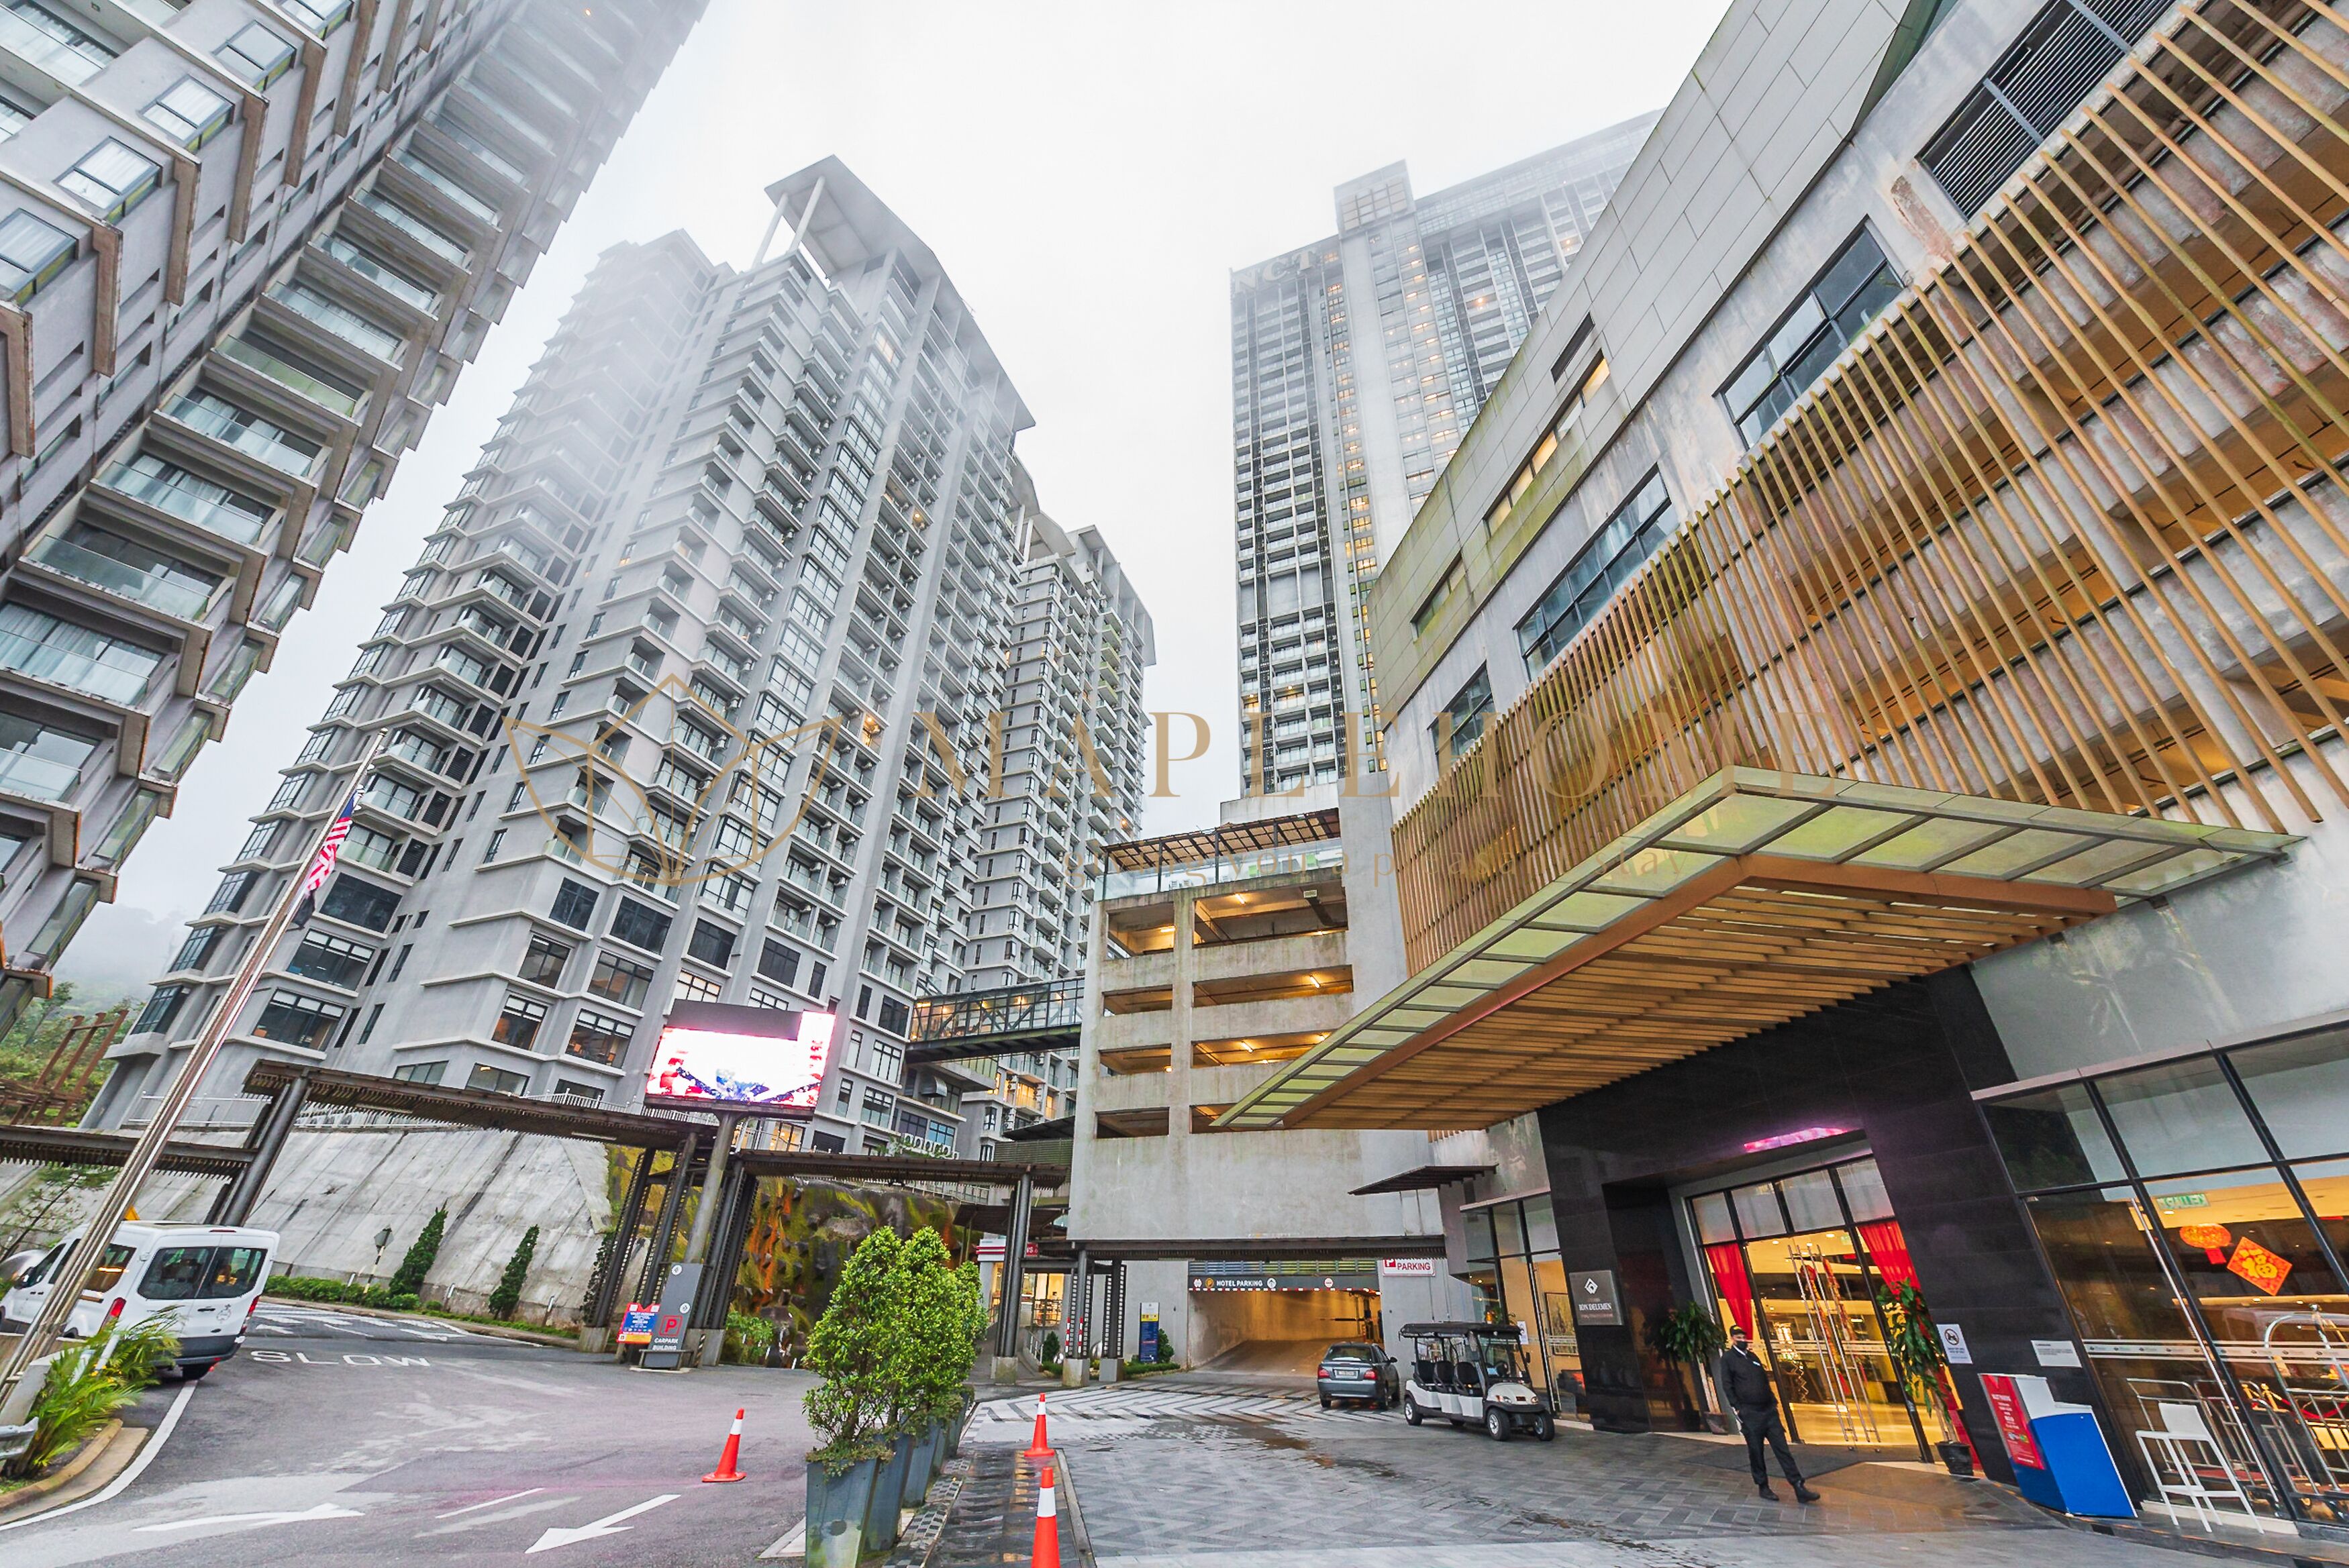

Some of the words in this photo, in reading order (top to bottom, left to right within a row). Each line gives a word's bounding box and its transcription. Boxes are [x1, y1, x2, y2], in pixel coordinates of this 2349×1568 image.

[1397, 1262, 1431, 1271] PARKING
[664, 1318, 677, 1334] P
[250, 1350, 431, 1367] SLOW
